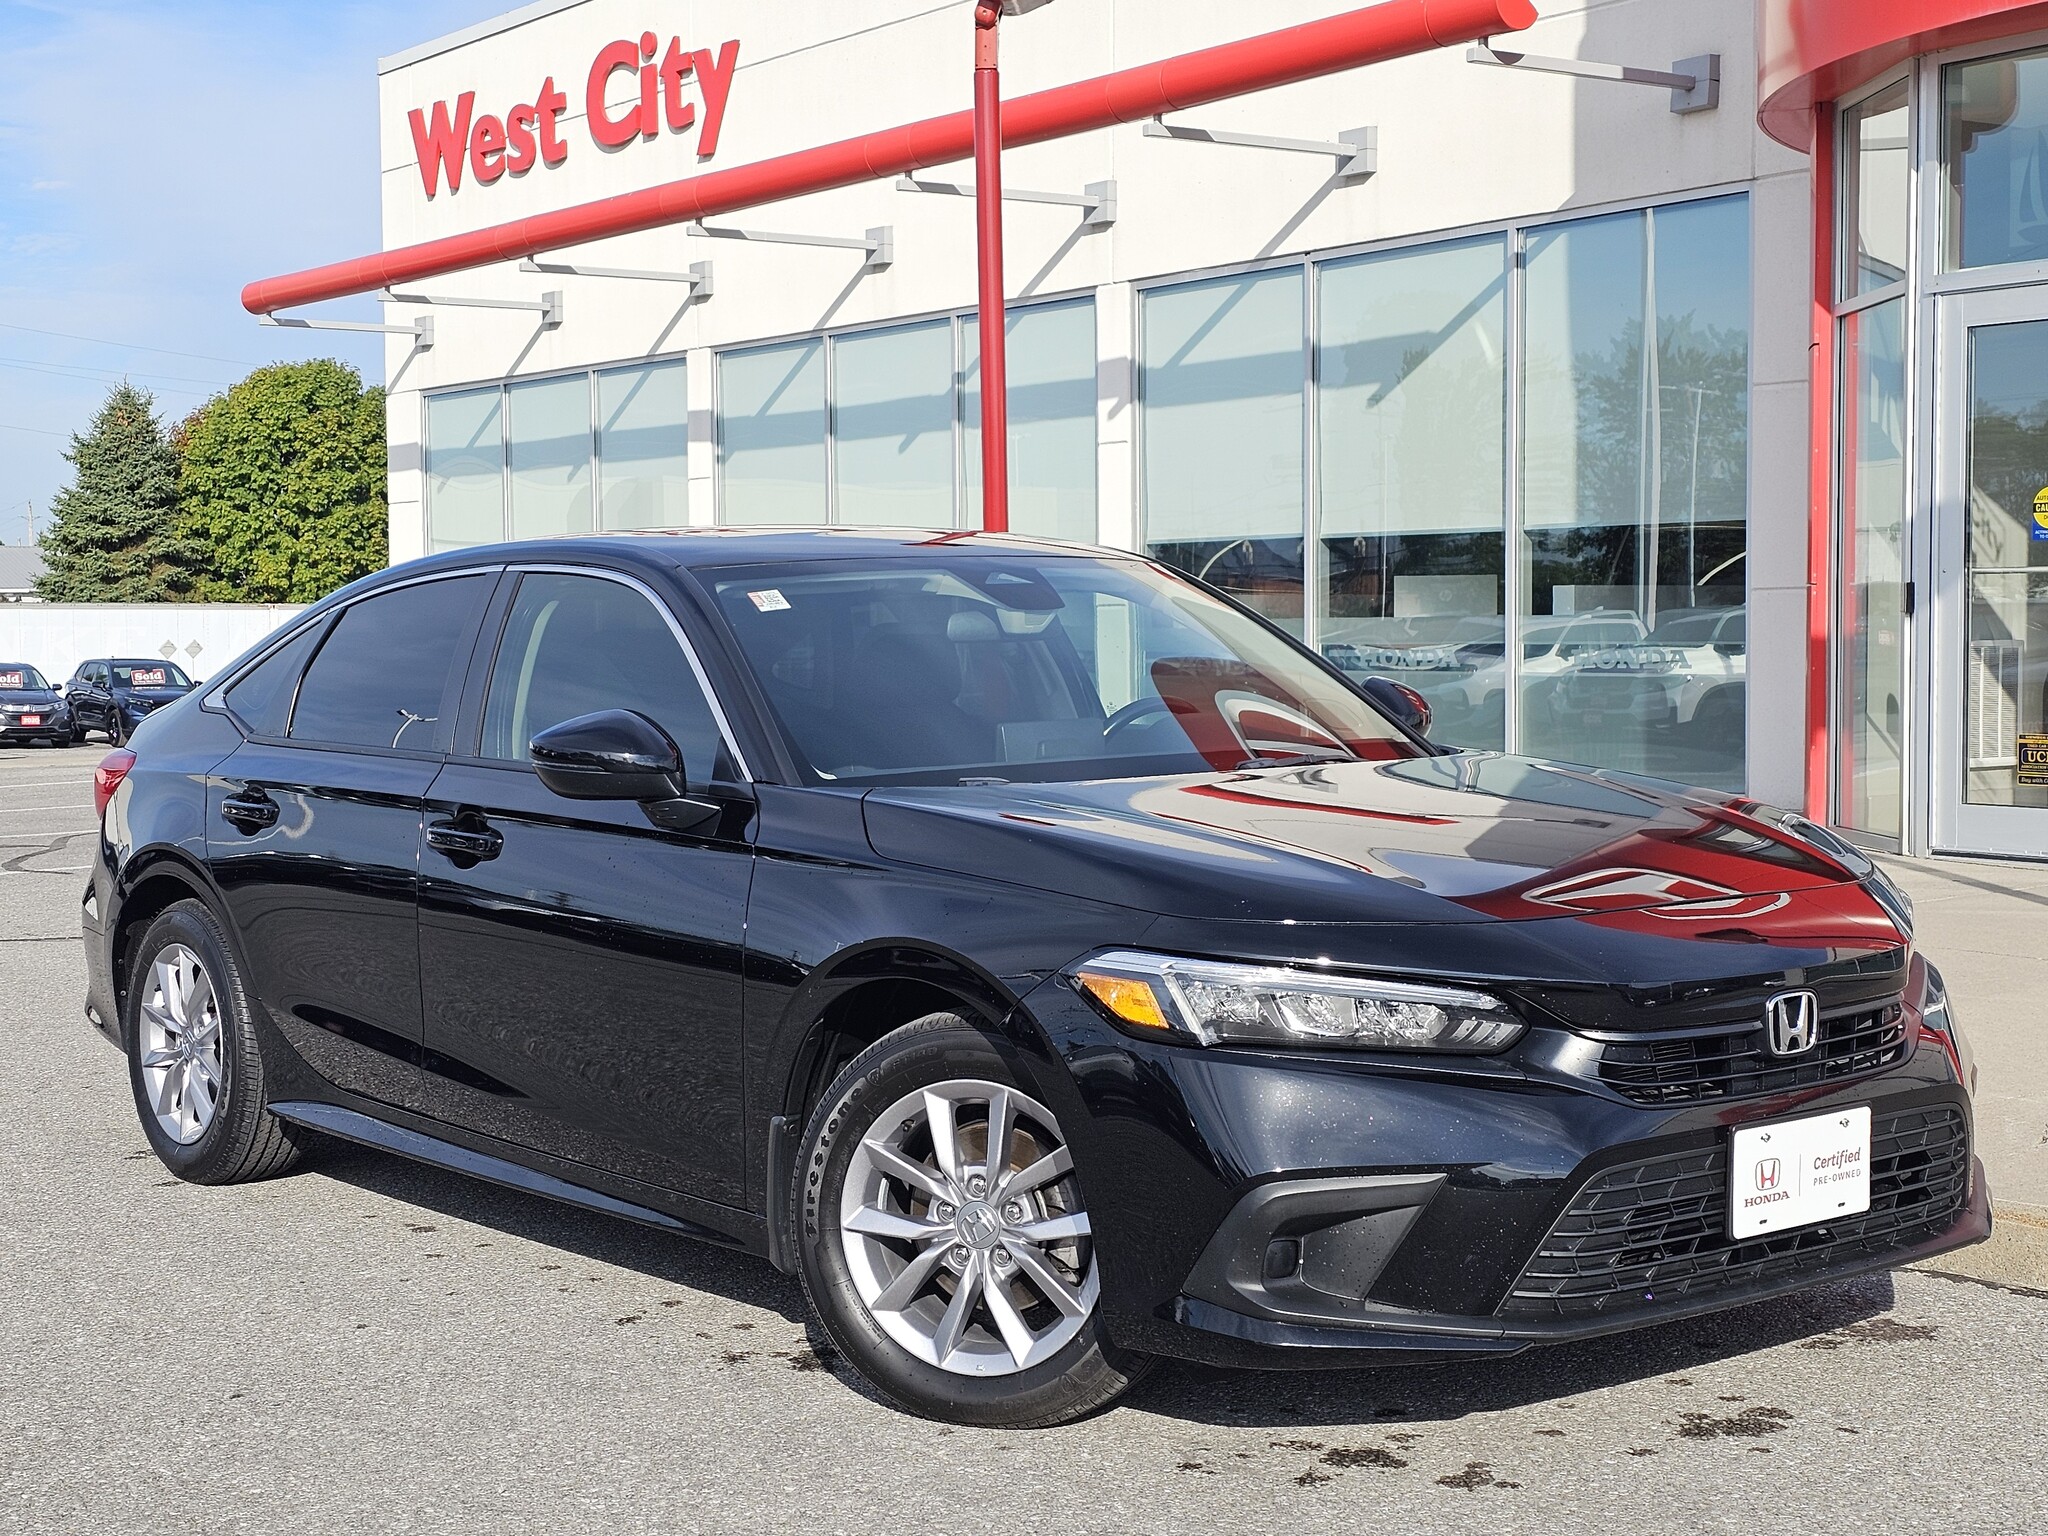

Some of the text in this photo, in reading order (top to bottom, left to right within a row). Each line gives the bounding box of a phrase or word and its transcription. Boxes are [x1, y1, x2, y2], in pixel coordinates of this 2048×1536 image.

[408, 31, 740, 201] West City
[1358, 648, 1461, 668] HONDA
[1570, 649, 1692, 669] HONDA
[0, 674, 20, 683] old
[134, 671, 163, 681] Sold
[1813, 1147, 1861, 1170] Certified
[1813, 1168, 1861, 1186] PRE-OWNED
[1744, 1190, 1790, 1207] HONDA
